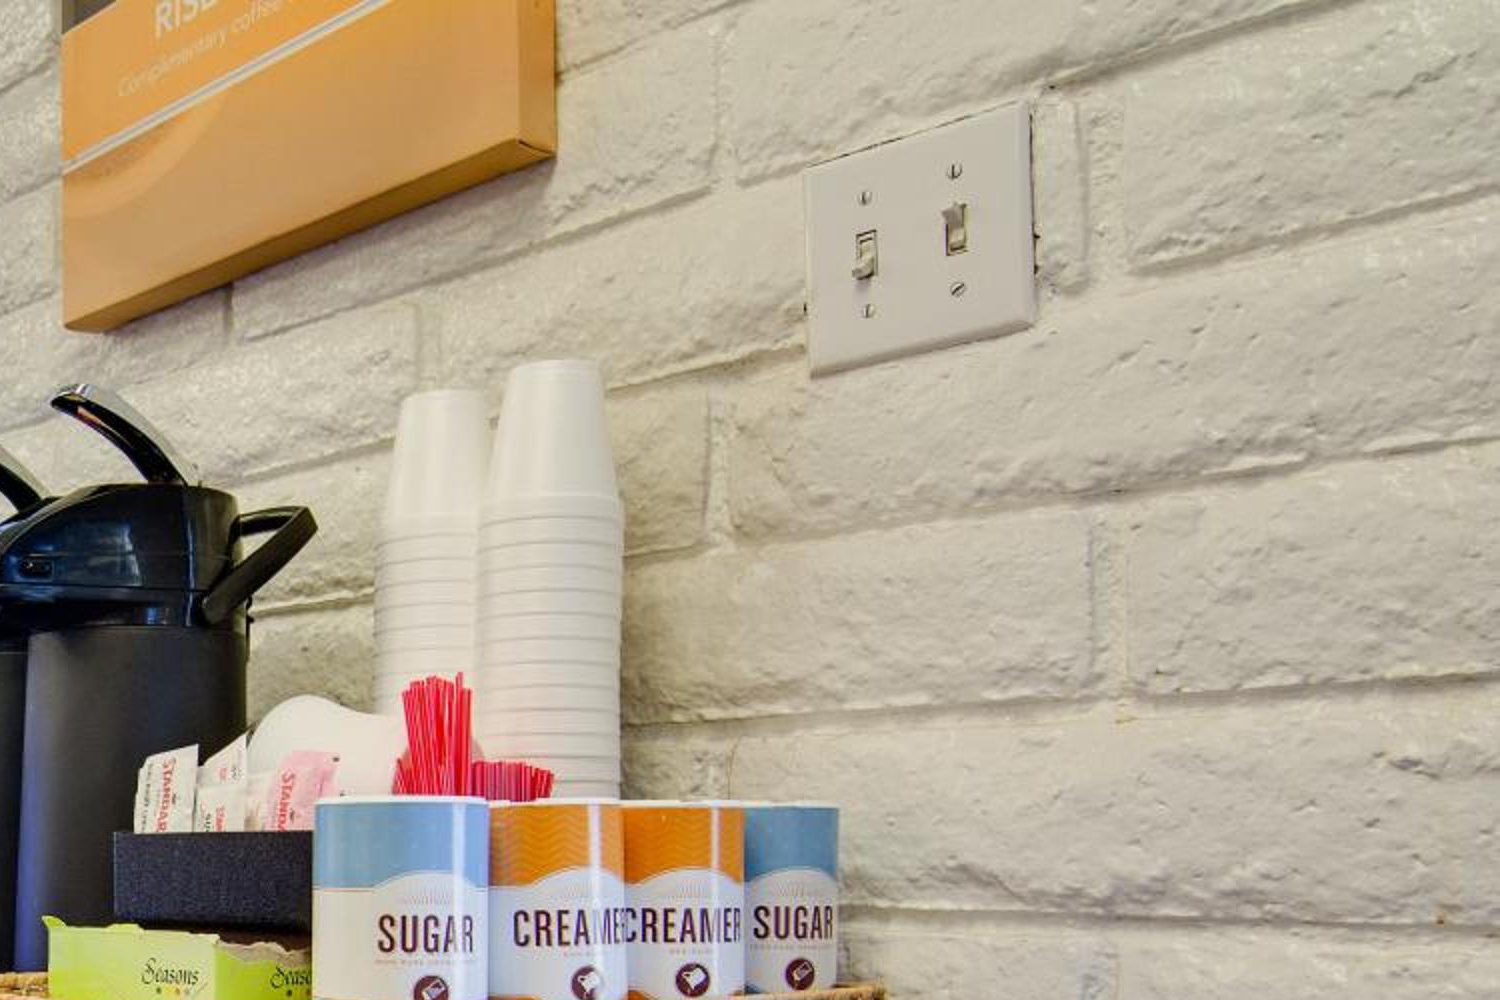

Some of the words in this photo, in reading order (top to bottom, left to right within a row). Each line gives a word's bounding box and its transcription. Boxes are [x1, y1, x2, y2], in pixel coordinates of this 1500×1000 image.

[155, 0, 216, 40] RIS
[377, 914, 473, 952] SUGAR
[753, 904, 833, 940] SUGAR
[141, 957, 200, 986] Seasons
